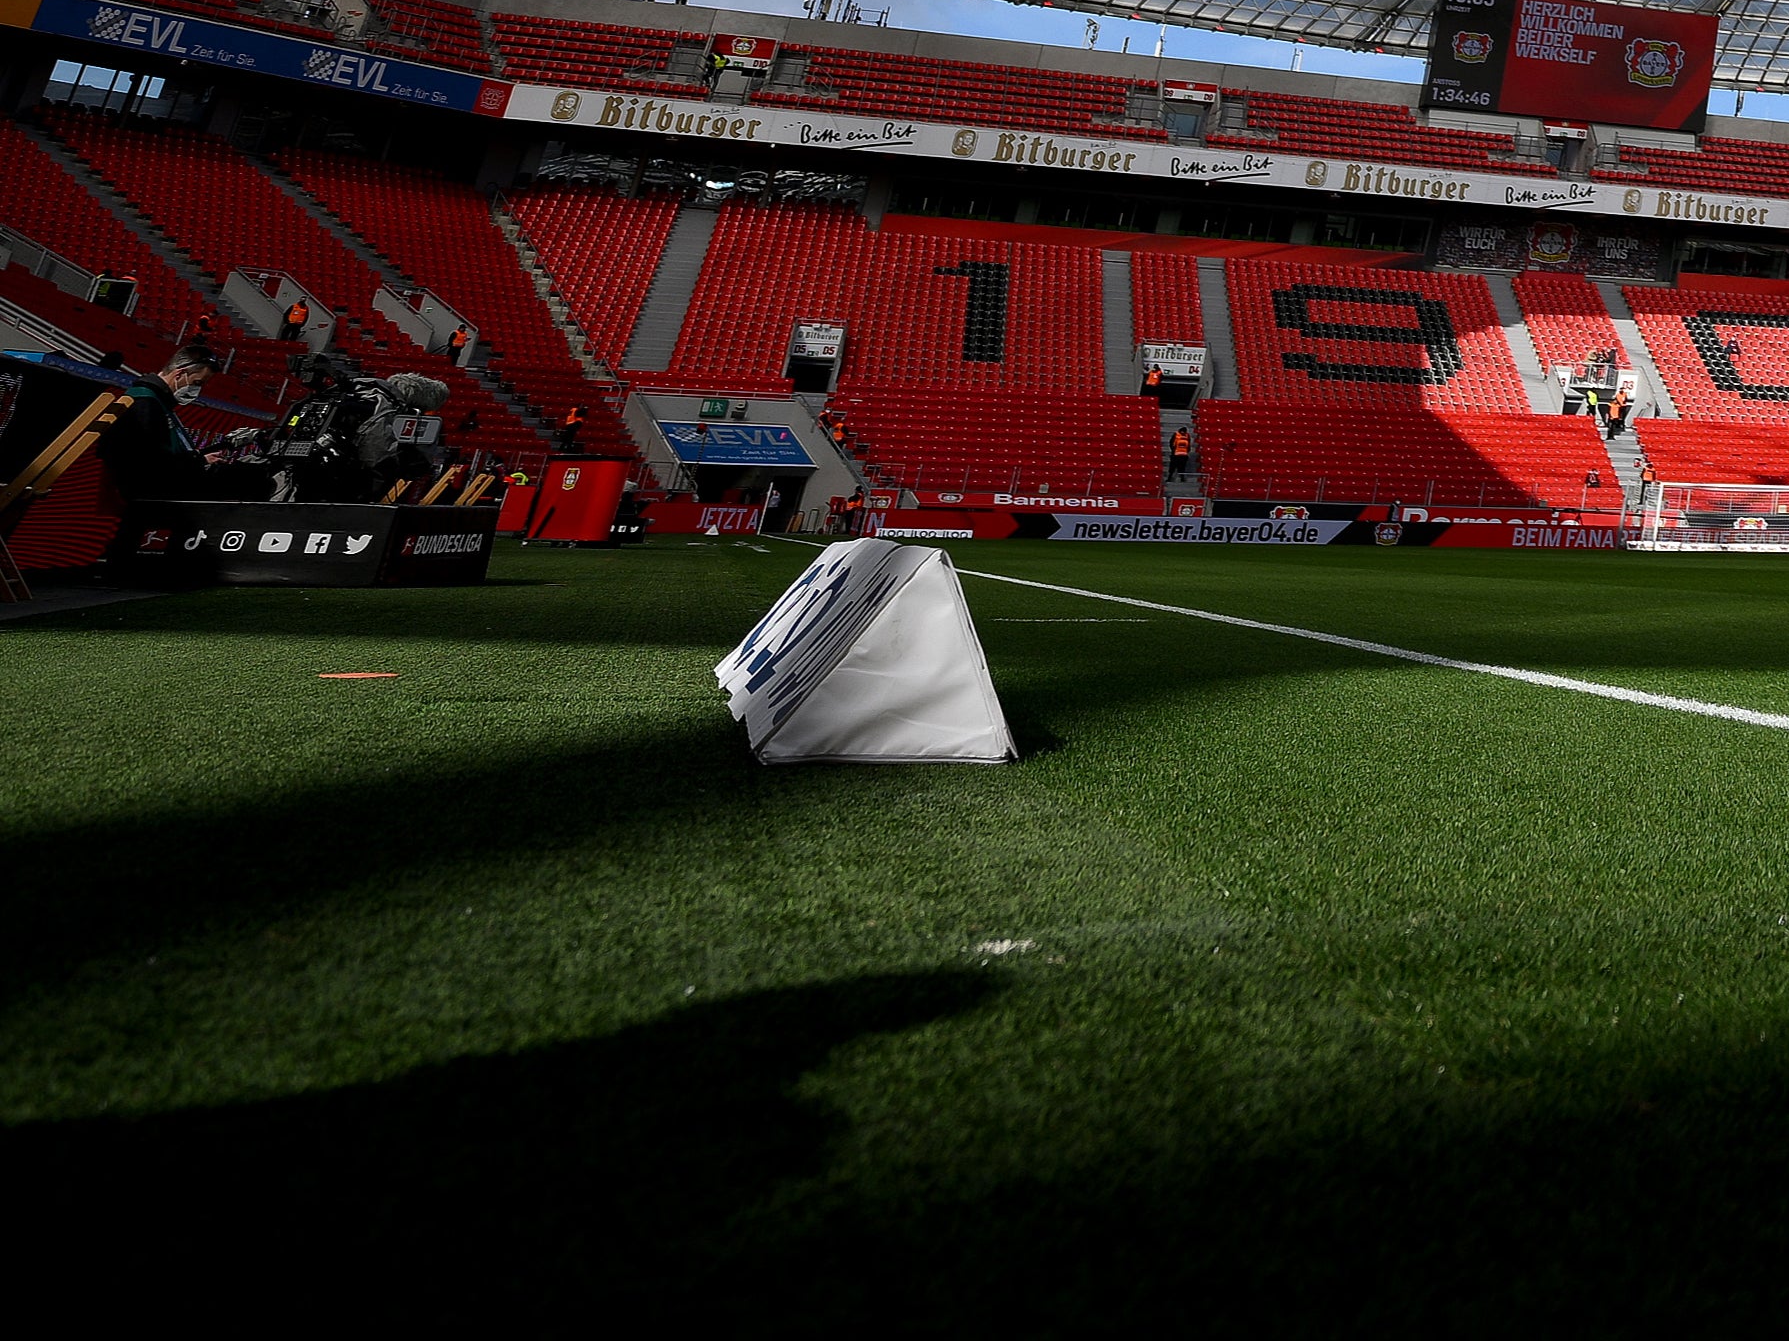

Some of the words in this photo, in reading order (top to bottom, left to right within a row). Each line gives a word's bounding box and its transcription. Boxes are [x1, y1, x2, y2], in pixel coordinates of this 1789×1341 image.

[1522, 0, 1596, 22] HERZLICH
[1517, 28, 1541, 45] BEI
[1542, 30, 1574, 48] DER
[1520, 15, 1625, 40] WILLKOMMEN
[121, 12, 188, 54] EVL
[190, 44, 214, 59] Zeit
[217, 48, 236, 62] für
[236, 53, 257, 68] Sie.
[1515, 42, 1598, 65] WERKSELF
[332, 54, 389, 92] EVL
[391, 83, 412, 98] Zeit
[414, 88, 431, 99] für
[432, 90, 449, 105] Sie.
[1432, 86, 1491, 106] 1:34:46
[596, 94, 762, 141] Bitburger
[800, 124, 842, 146] Bitte
[846, 131, 878, 141] ein
[882, 121, 917, 140] Bit
[992, 132, 1136, 172] Bitburger
[1171, 157, 1207, 176] Bitte
[1211, 162, 1241, 173] ein
[1242, 154, 1274, 171] Bit
[1341, 163, 1471, 201] Bitburger
[1506, 186, 1538, 204] Bitte
[1541, 192, 1567, 201] ein
[1569, 183, 1597, 199] Bit
[1654, 191, 1769, 225] Bitburger
[1459, 225, 1484, 240] WIR
[1465, 237, 1496, 250] EUCH
[1604, 247, 1629, 260] UNS
[805, 328, 839, 341] Bitburger
[794, 345, 806, 354] D5
[822, 346, 836, 355] D5
[1154, 347, 1203, 362] Bitburger
[1188, 365, 1200, 374] D4
[708, 428, 792, 446] EVL
[993, 493, 1120, 508] Barmenia
[696, 506, 748, 531] JETZT
[1073, 519, 1319, 543] newsletter.bayer04.de
[1512, 526, 1563, 548] BEIM
[414, 533, 484, 554] BUNDESLIGA
